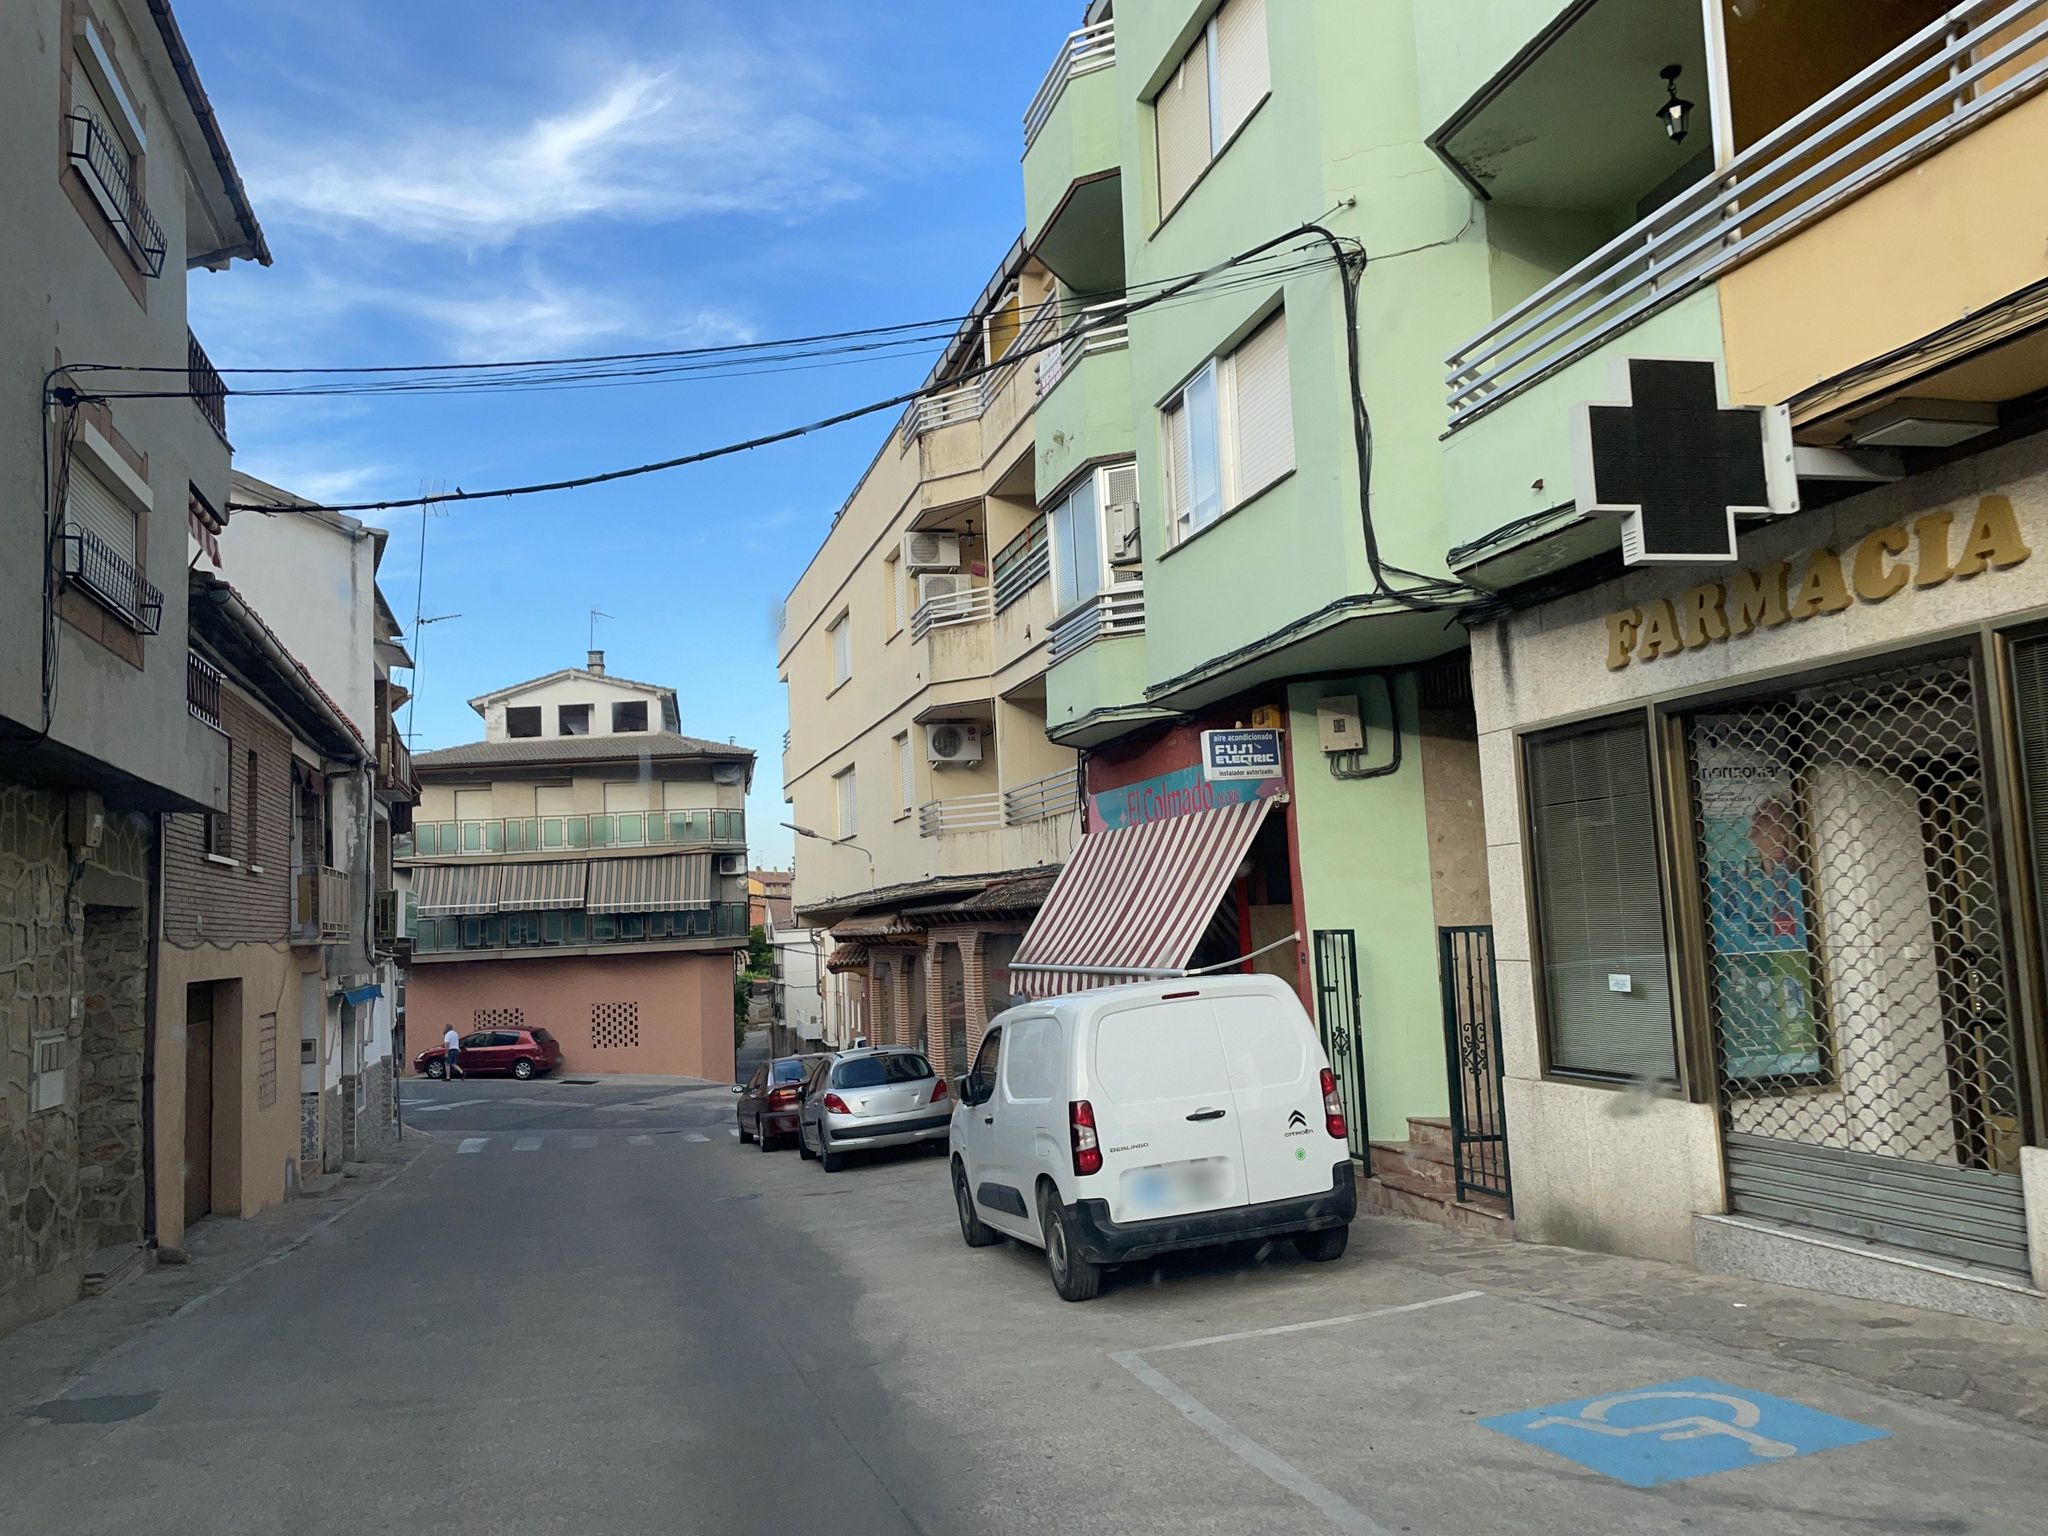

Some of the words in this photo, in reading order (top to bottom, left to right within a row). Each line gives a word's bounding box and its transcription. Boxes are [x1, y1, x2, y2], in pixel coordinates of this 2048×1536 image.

[1605, 494, 2033, 671] FARMACIA
[1213, 734, 1227, 742] aire
[1227, 732, 1273, 742] acondicionado
[1214, 743, 1254, 755] FUJI
[1215, 753, 1275, 765] ELECTRIC
[1218, 769, 1245, 777] instalador
[1246, 768, 1274, 776] autorizado
[1127, 786, 1141, 827] El
[1143, 771, 1214, 824] Colmado
[1109, 1142, 1149, 1153] BERLINGO
